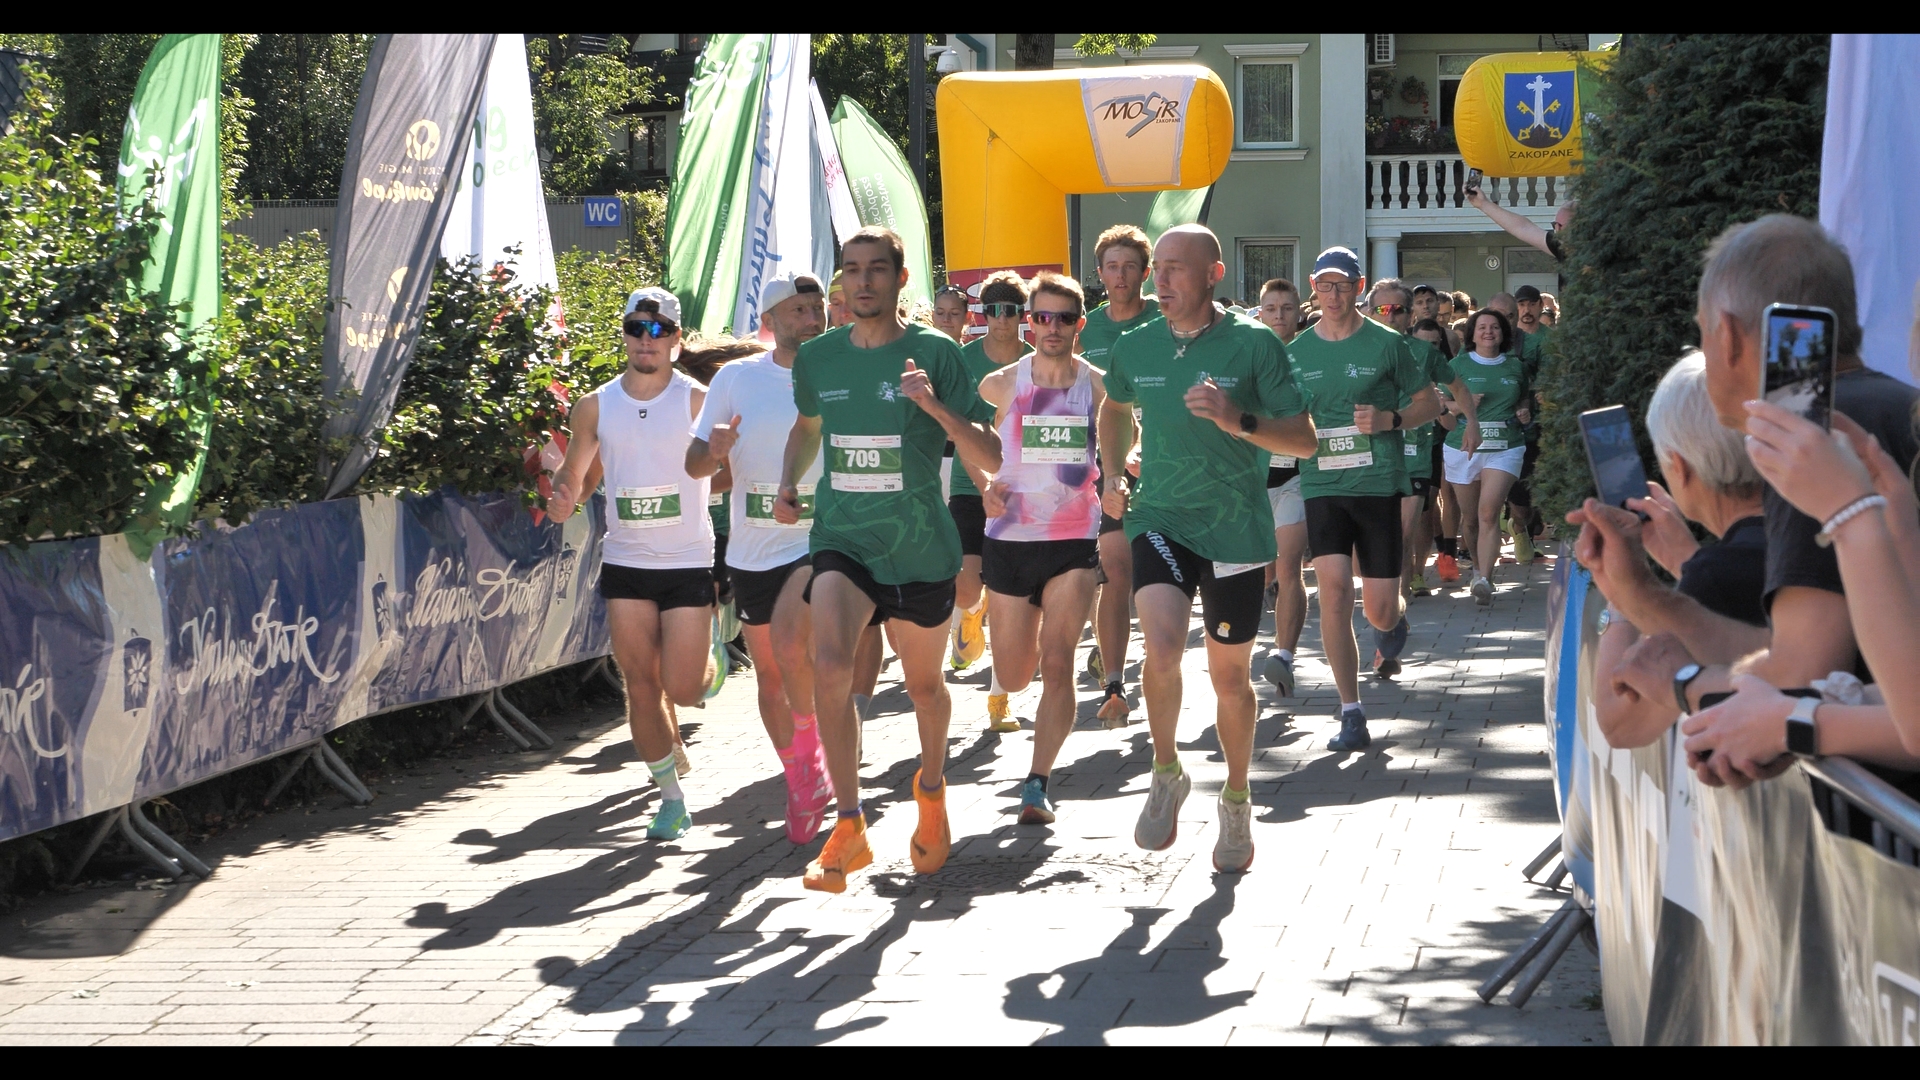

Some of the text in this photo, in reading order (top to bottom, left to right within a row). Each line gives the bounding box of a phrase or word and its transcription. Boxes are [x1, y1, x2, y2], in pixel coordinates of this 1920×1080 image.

[1509, 149, 1574, 159] ZAKOPANE
[587, 202, 617, 222] WC
[1040, 427, 1071, 443] 344
[1482, 428, 1499, 437] 266
[1329, 436, 1354, 452] 655
[844, 449, 880, 468] 709
[630, 497, 662, 515] 527
